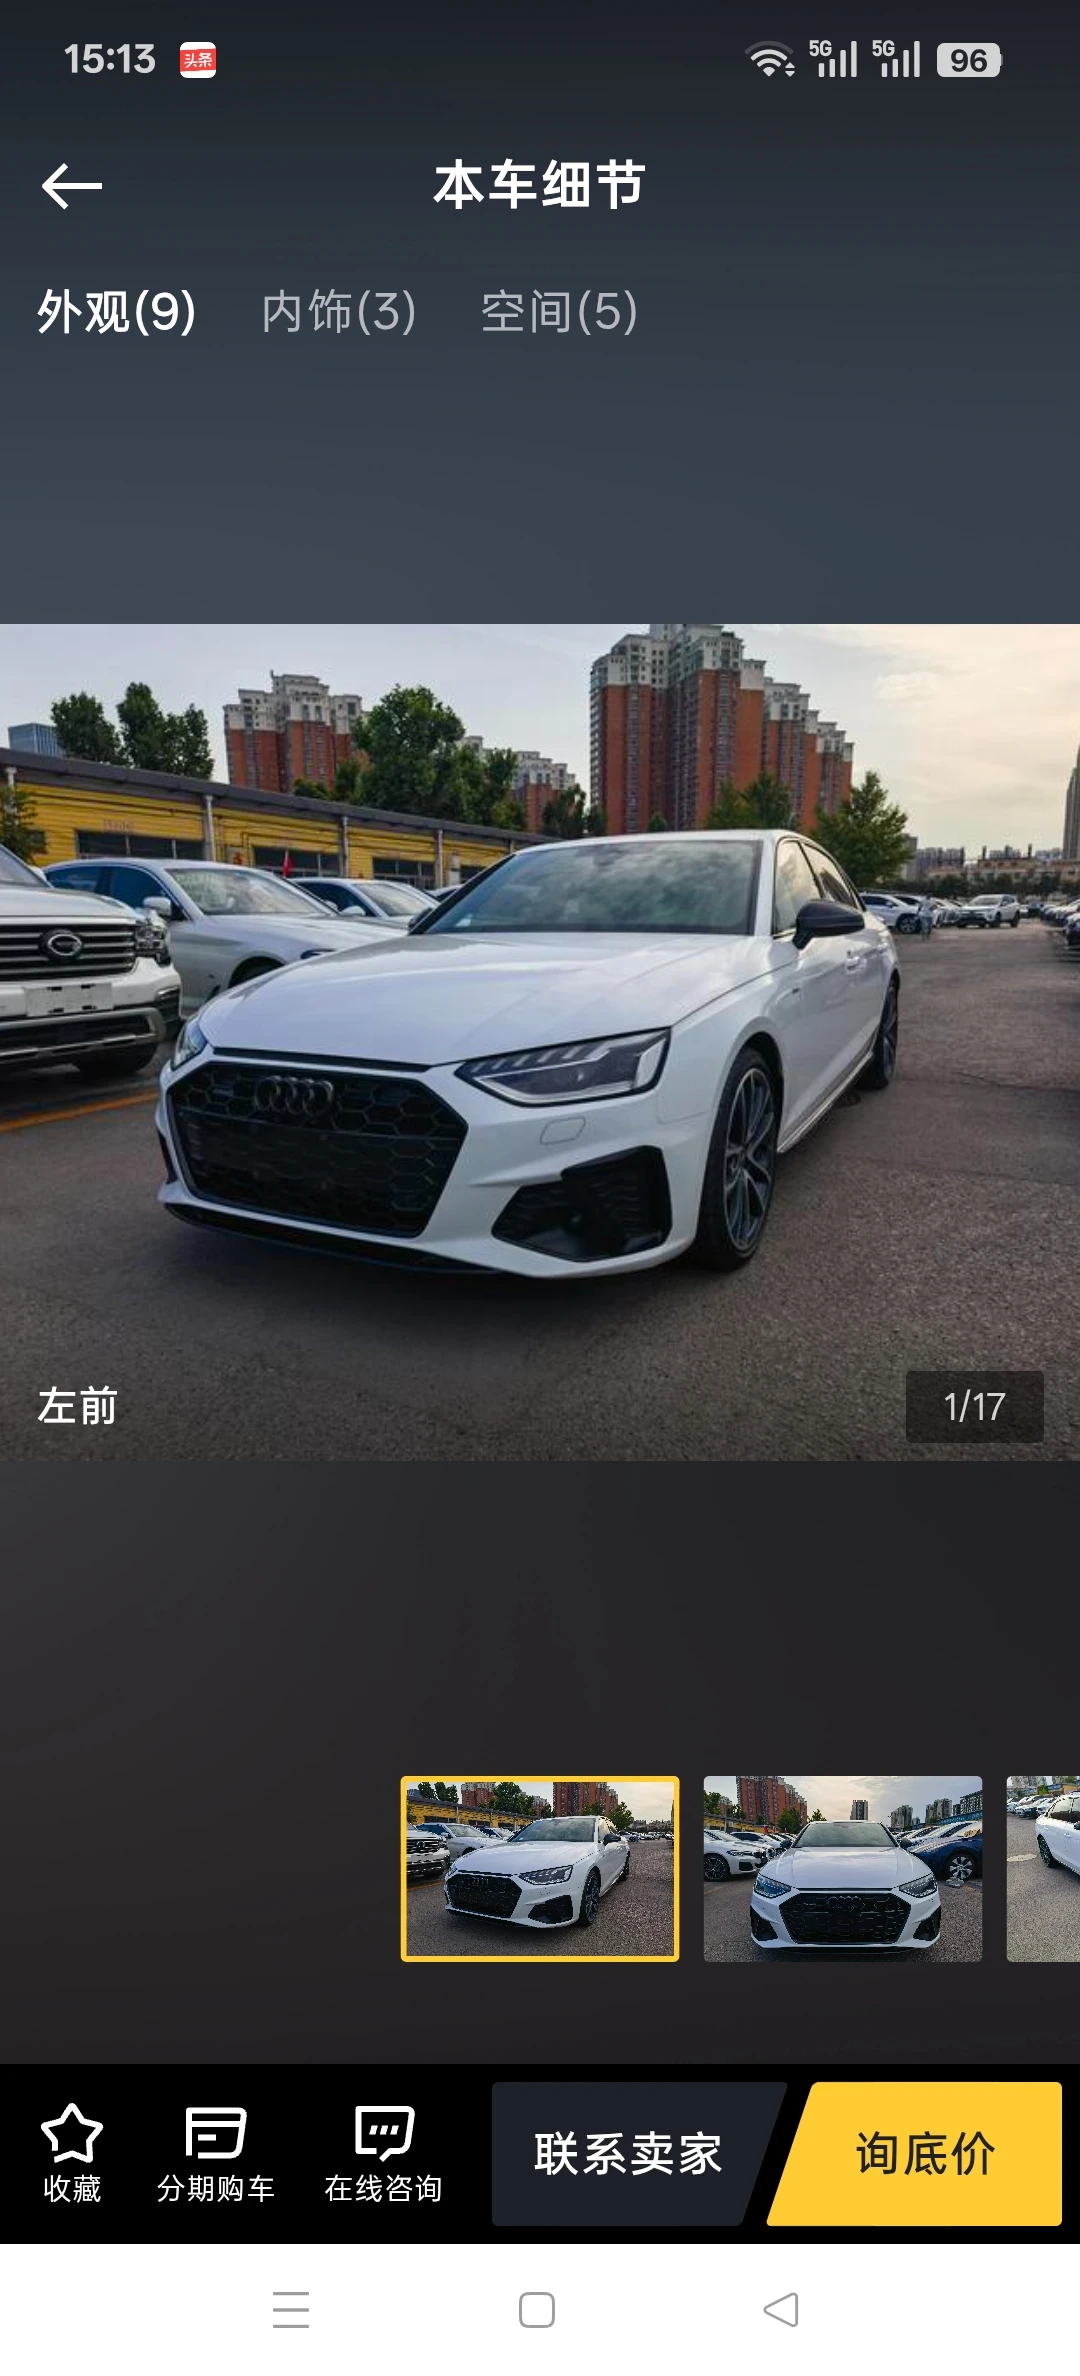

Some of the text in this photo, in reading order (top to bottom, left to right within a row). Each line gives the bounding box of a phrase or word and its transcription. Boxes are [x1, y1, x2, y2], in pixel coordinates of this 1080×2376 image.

[64, 43, 156, 74] 15:13
[184, 52, 213, 69] 头条
[809, 39, 833, 57] 5G
[872, 39, 896, 57] 5G
[950, 48, 988, 73] 96
[432, 157, 646, 210] 本车细节
[36, 288, 197, 337] 外观(9)
[262, 288, 417, 337] 内饰(3)
[481, 288, 639, 337] 空间(5)
[533, 2130, 723, 2176] 联系卖家
[856, 2130, 996, 2176] 询底价
[43, 2173, 102, 2204] 收藏
[156, 2173, 275, 2203] 分期购车
[324, 2173, 442, 2203] 在线咨询
